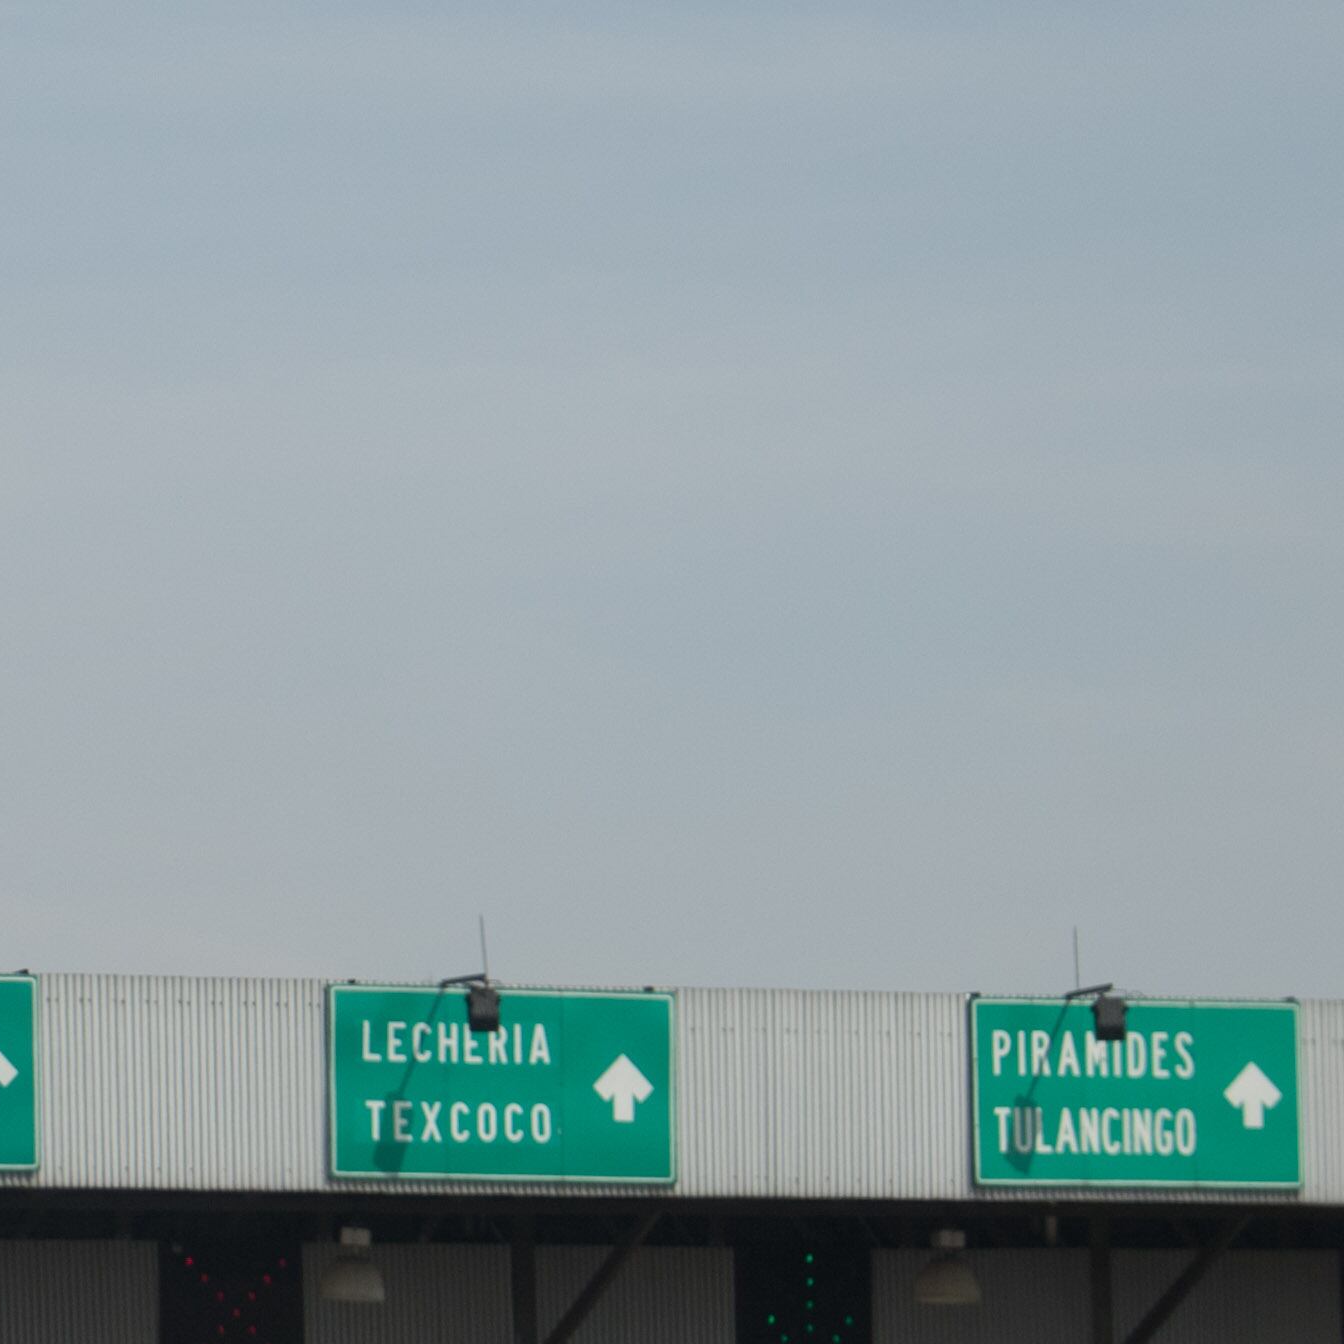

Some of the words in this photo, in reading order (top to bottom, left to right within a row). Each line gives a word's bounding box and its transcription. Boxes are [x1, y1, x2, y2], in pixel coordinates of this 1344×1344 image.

[362, 1020, 551, 1065] LECHERIA
[991, 1029, 1195, 1080] PIRAMIDES
[365, 1100, 552, 1145] TEXCOCO
[994, 1106, 1197, 1156] TULANCINGO
